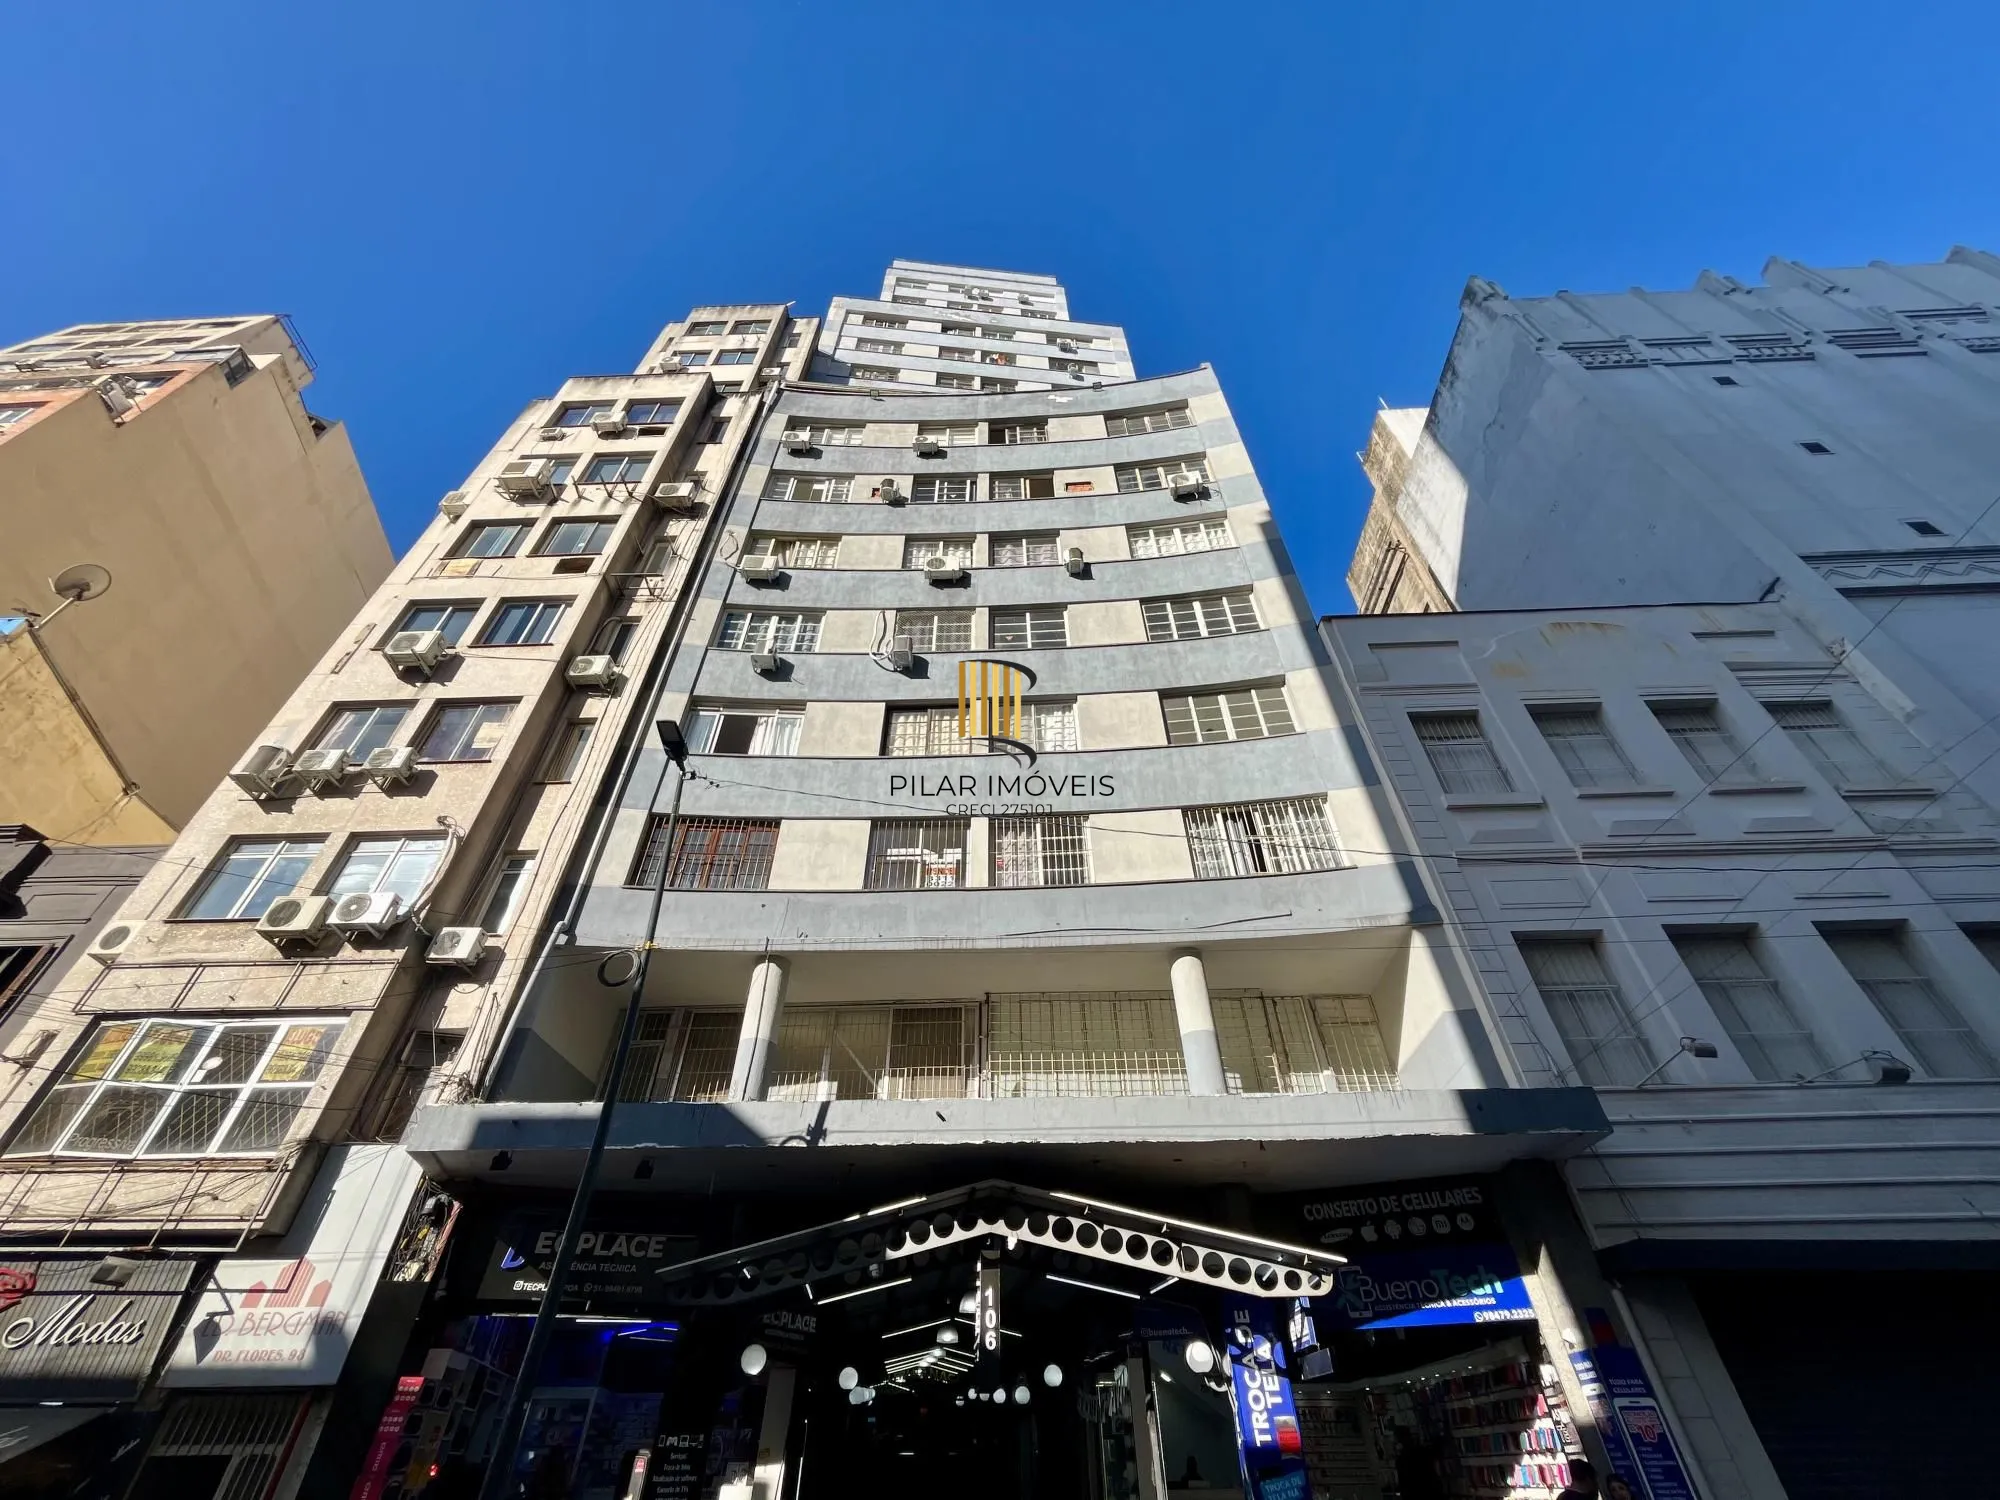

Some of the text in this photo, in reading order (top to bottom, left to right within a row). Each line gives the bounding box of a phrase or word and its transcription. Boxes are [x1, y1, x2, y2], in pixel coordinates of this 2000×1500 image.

[1303, 1186, 1483, 1221] CONSERTO DE CELULARES
[1356, 1264, 1504, 1303] BuenoTech
[1452, 1296, 1497, 1308] ACESSÓRIOS
[2, 1294, 145, 1348] Modas
[238, 1310, 349, 1337] BERGMAN
[984, 1285, 997, 1351] 106
[287, 1348, 306, 1361] 98
[1234, 1309, 1273, 1448] TROCA DE
[1254, 1341, 1283, 1409] TELA
